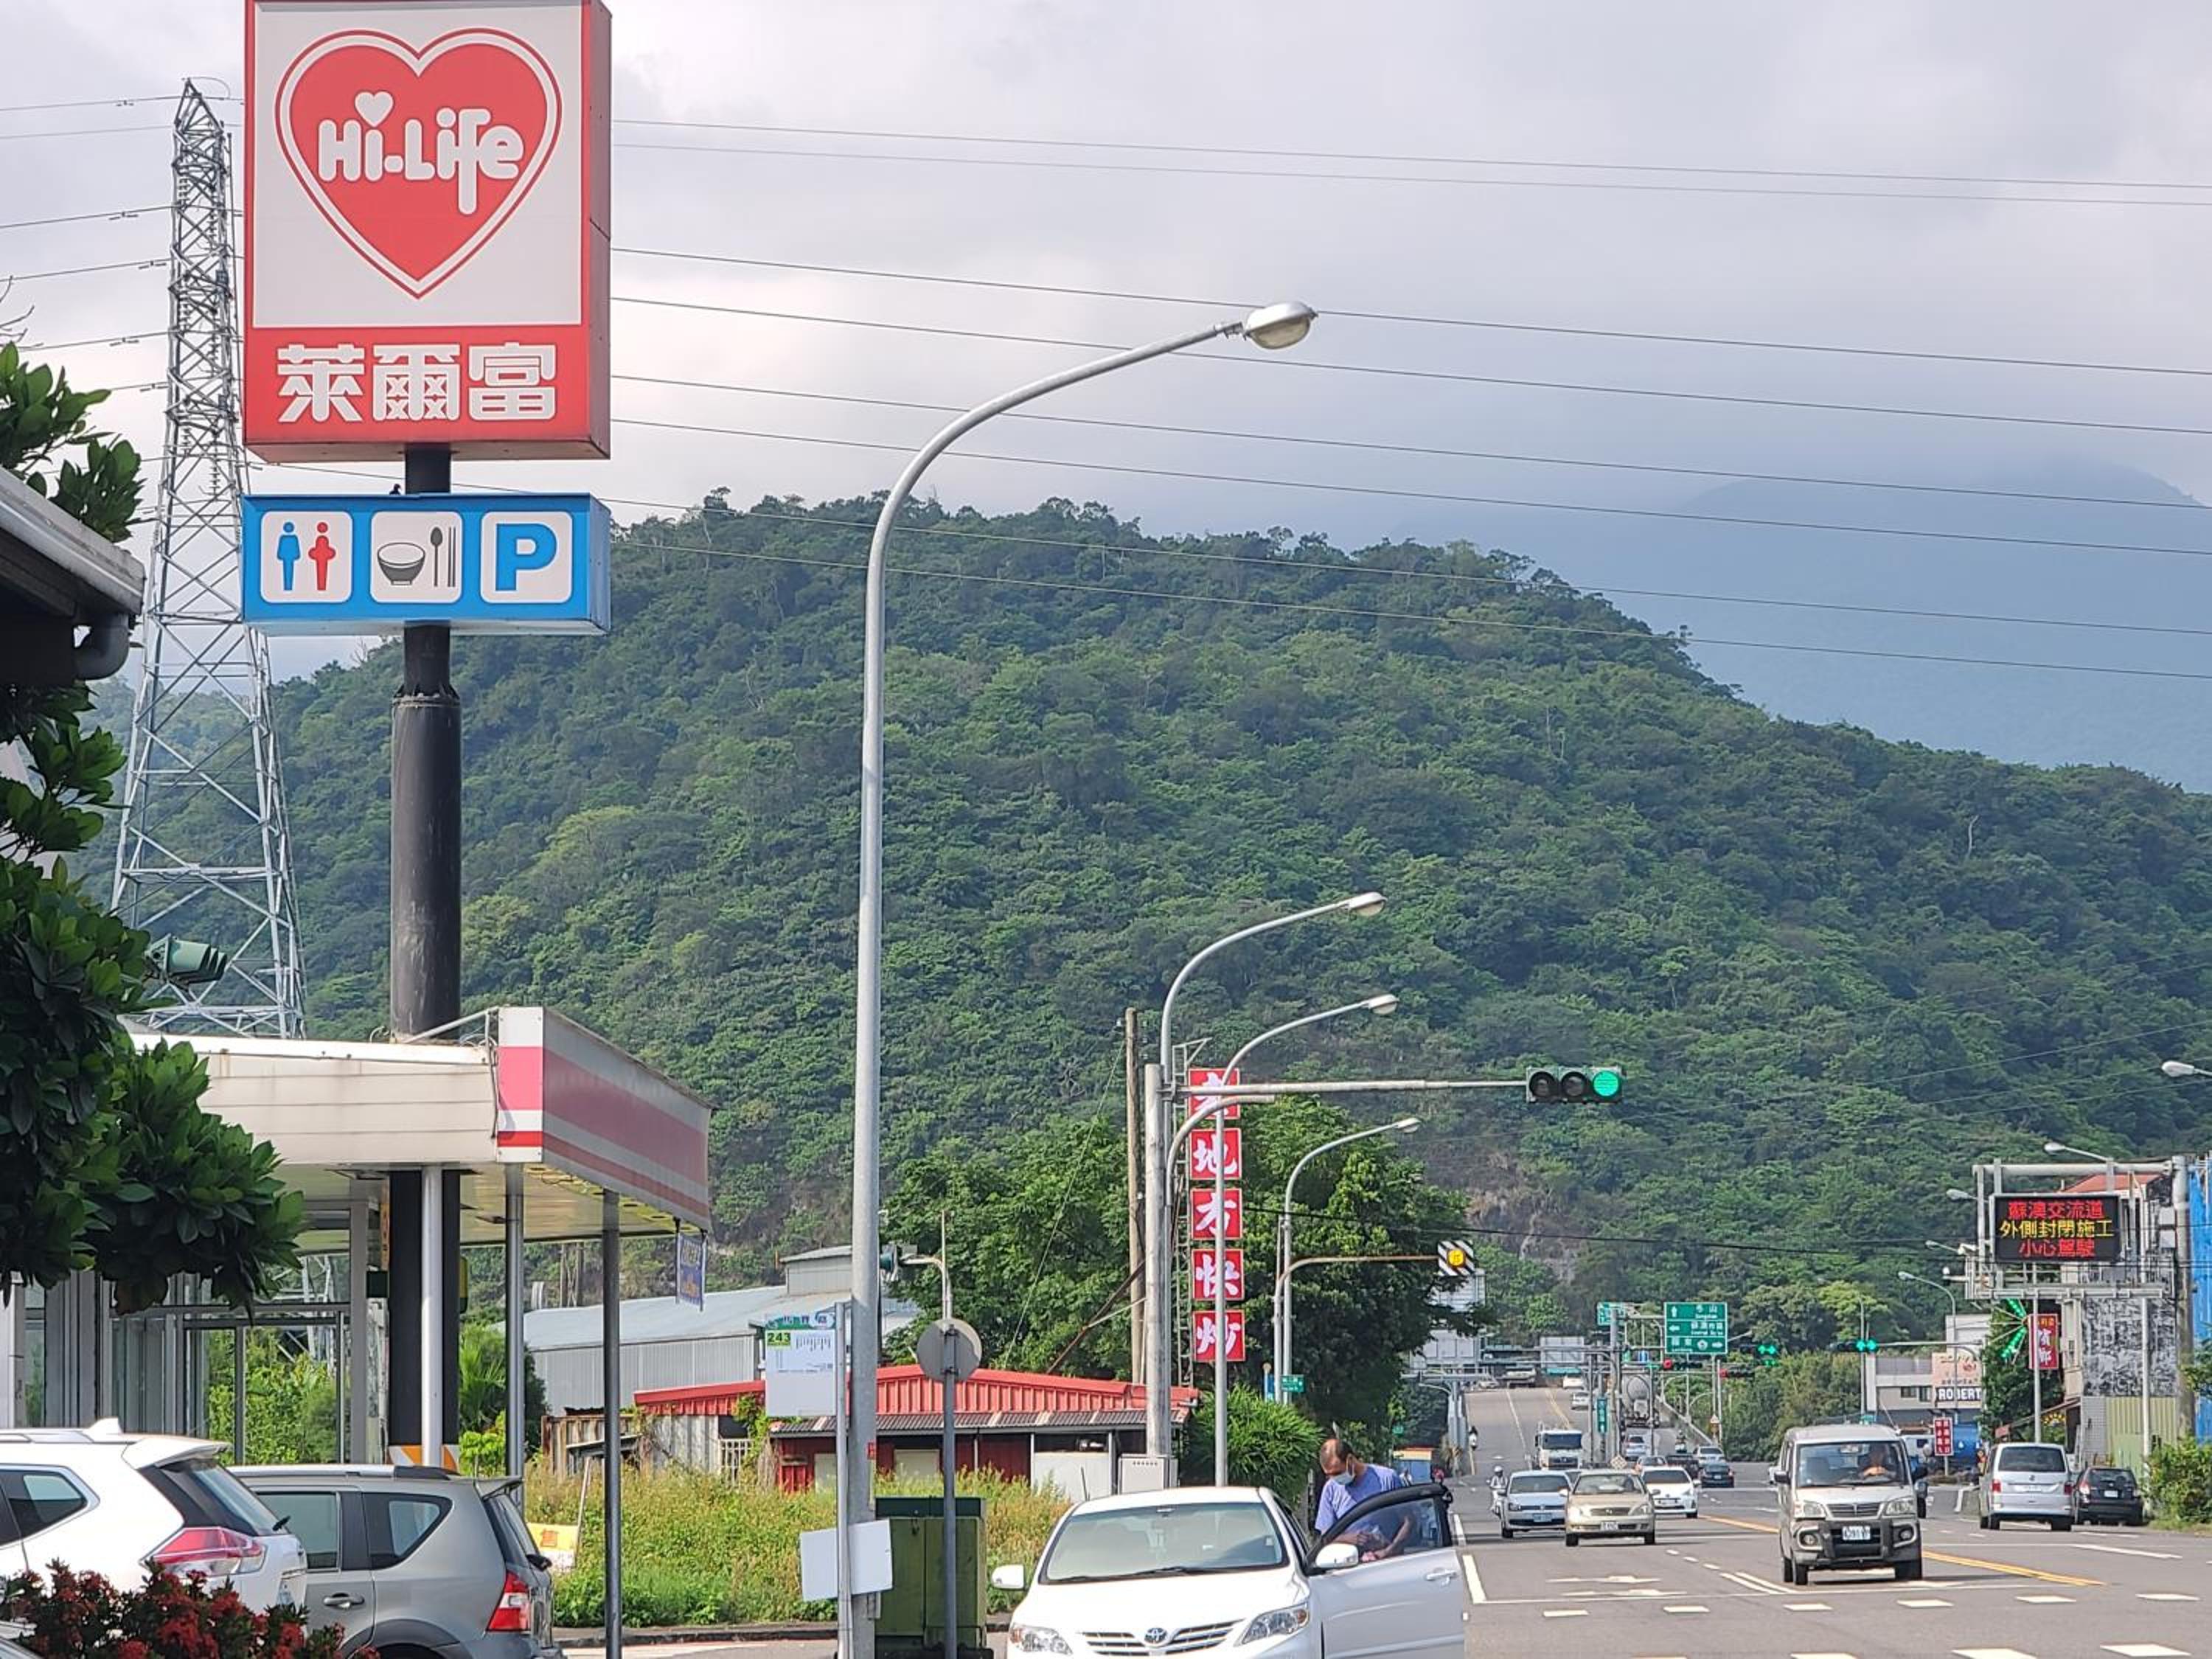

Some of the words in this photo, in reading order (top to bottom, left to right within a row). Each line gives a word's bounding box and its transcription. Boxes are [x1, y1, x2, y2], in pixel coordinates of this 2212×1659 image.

[318, 91, 524, 214] Hi-Life
[276, 341, 556, 423] 萊爾富
[496, 523, 557, 591] P
[2008, 1200, 2104, 1219] 蘇澳交流道
[2000, 1220, 2114, 1239] 外側封閉施工
[2019, 1239, 2096, 1257] 小心駕駛
[768, 1333, 790, 1342] 243
